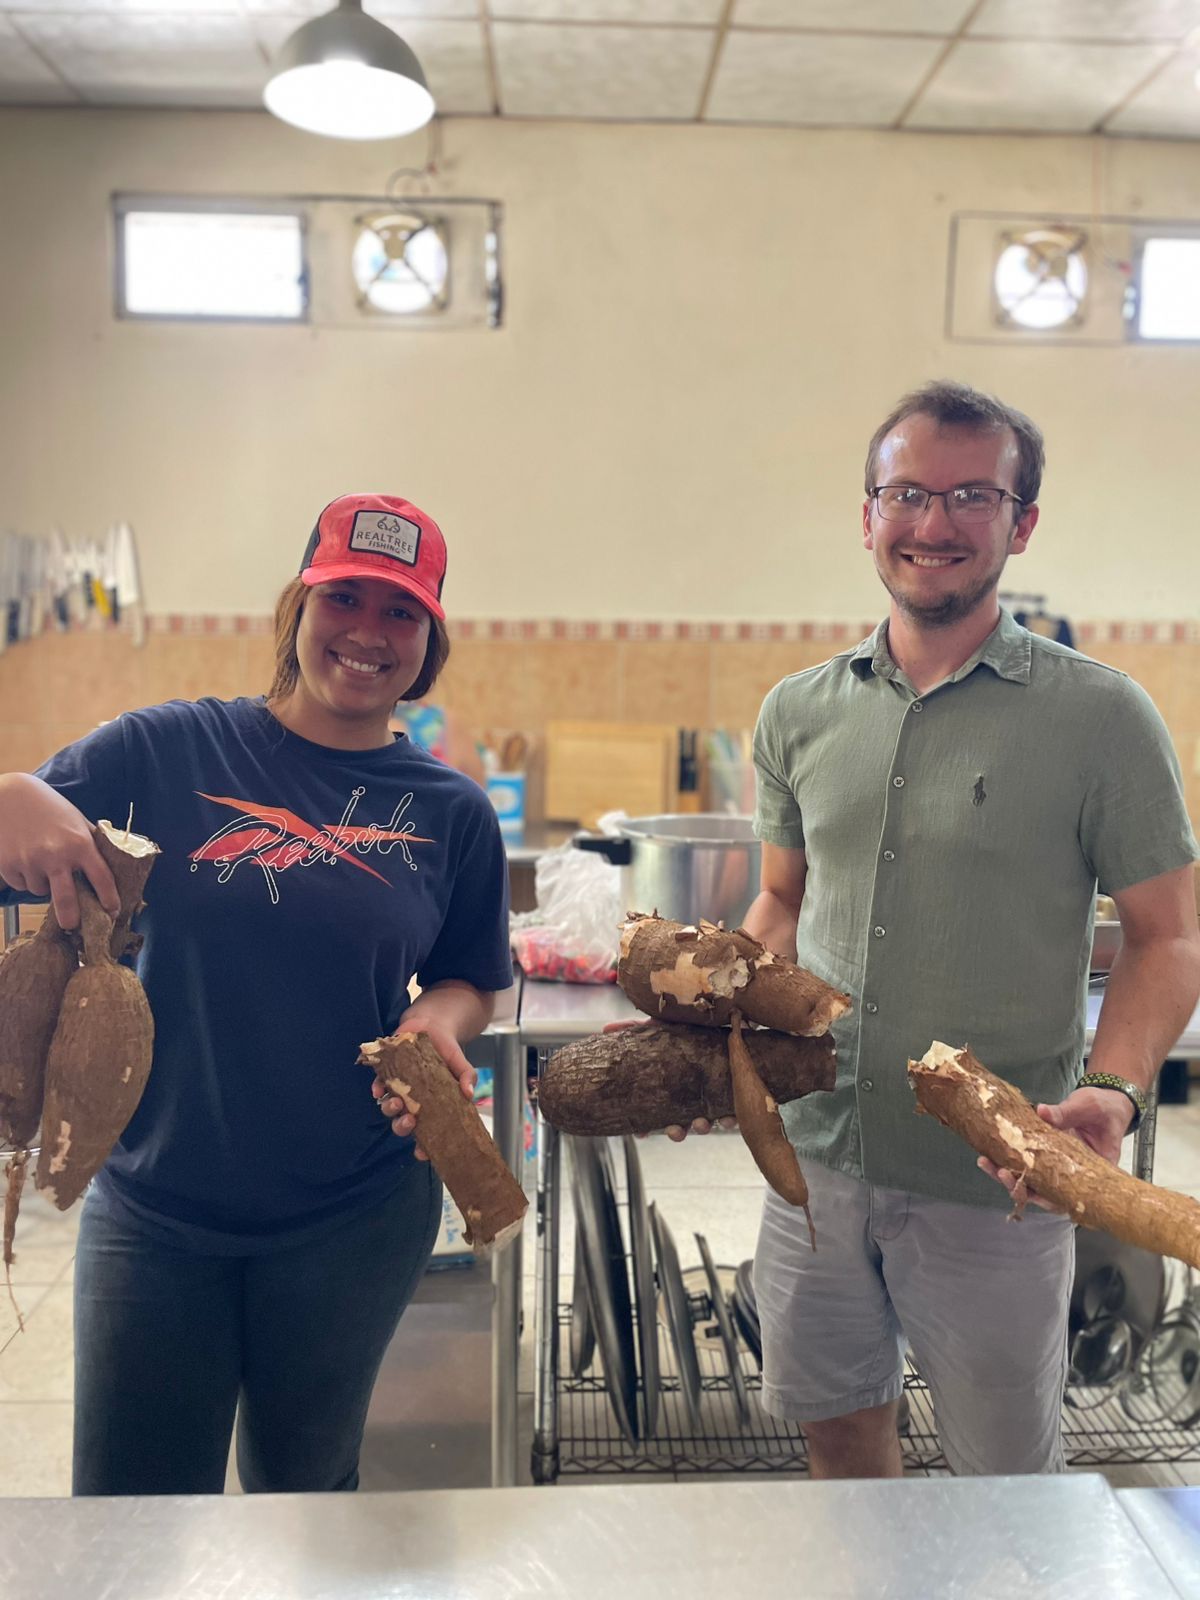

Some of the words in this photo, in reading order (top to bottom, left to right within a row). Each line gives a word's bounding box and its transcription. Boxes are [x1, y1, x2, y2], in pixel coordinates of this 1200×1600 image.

[356, 531, 413, 554] REALTREE
[368, 540, 401, 554] FISHING
[189, 786, 418, 904] Reebok
